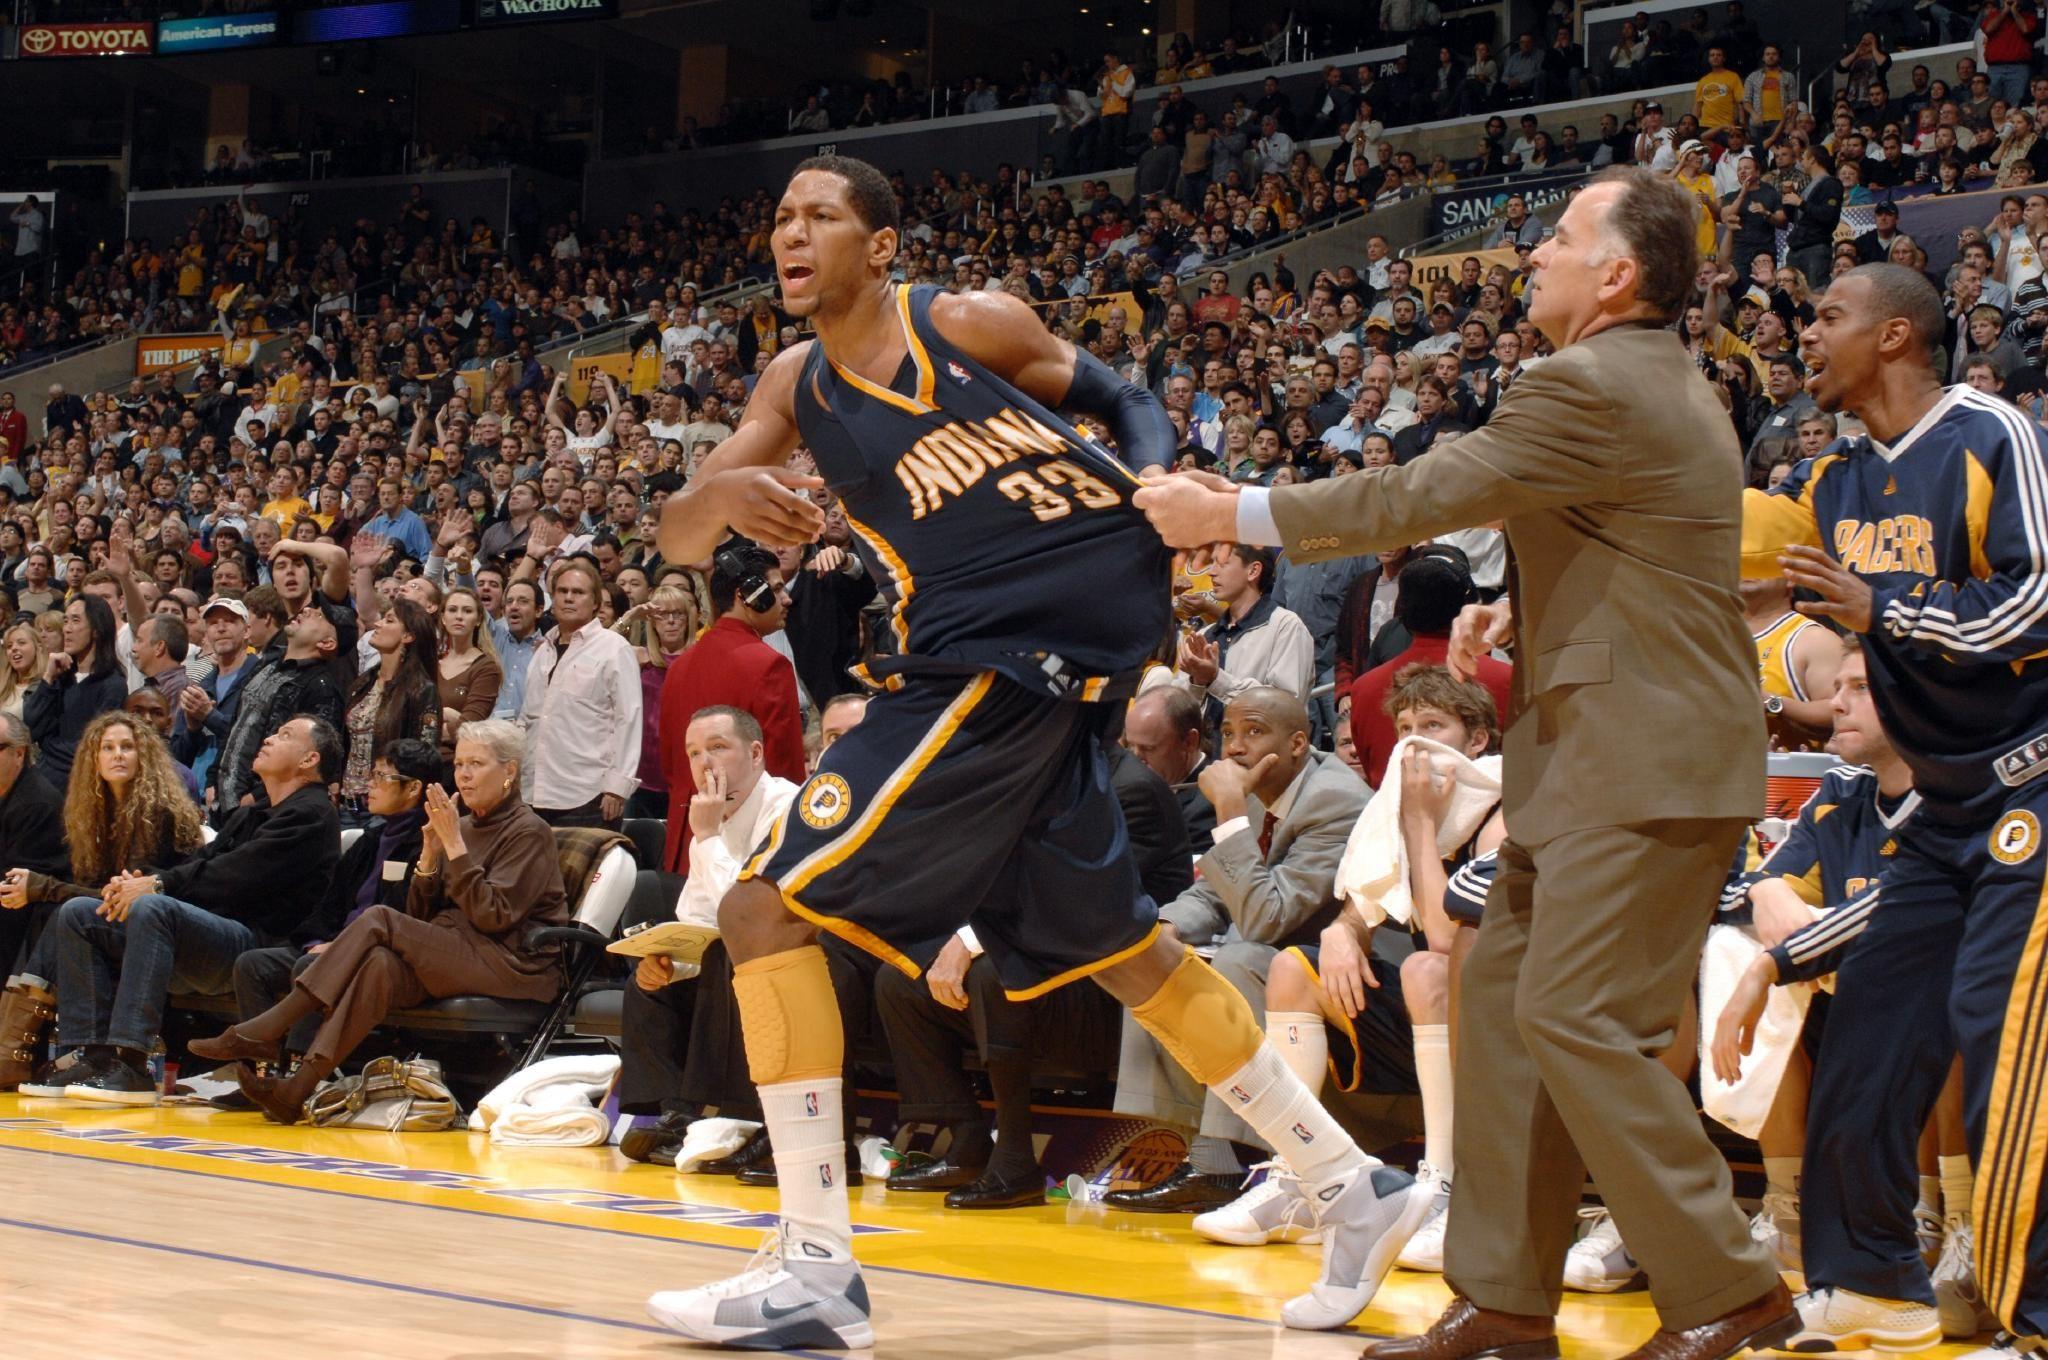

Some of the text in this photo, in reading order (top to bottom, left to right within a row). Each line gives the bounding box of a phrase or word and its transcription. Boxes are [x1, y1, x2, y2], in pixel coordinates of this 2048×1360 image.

[502, 0, 602, 14] WACHOVIA
[59, 29, 149, 49] TOYOTA
[160, 22, 276, 43] American Express
[1443, 197, 1492, 225] SAN
[1417, 265, 1449, 285] 101
[142, 350, 174, 366] THE
[641, 345, 656, 359] 24
[997, 459, 1121, 522] 33
[1834, 514, 1937, 577] PACERS
